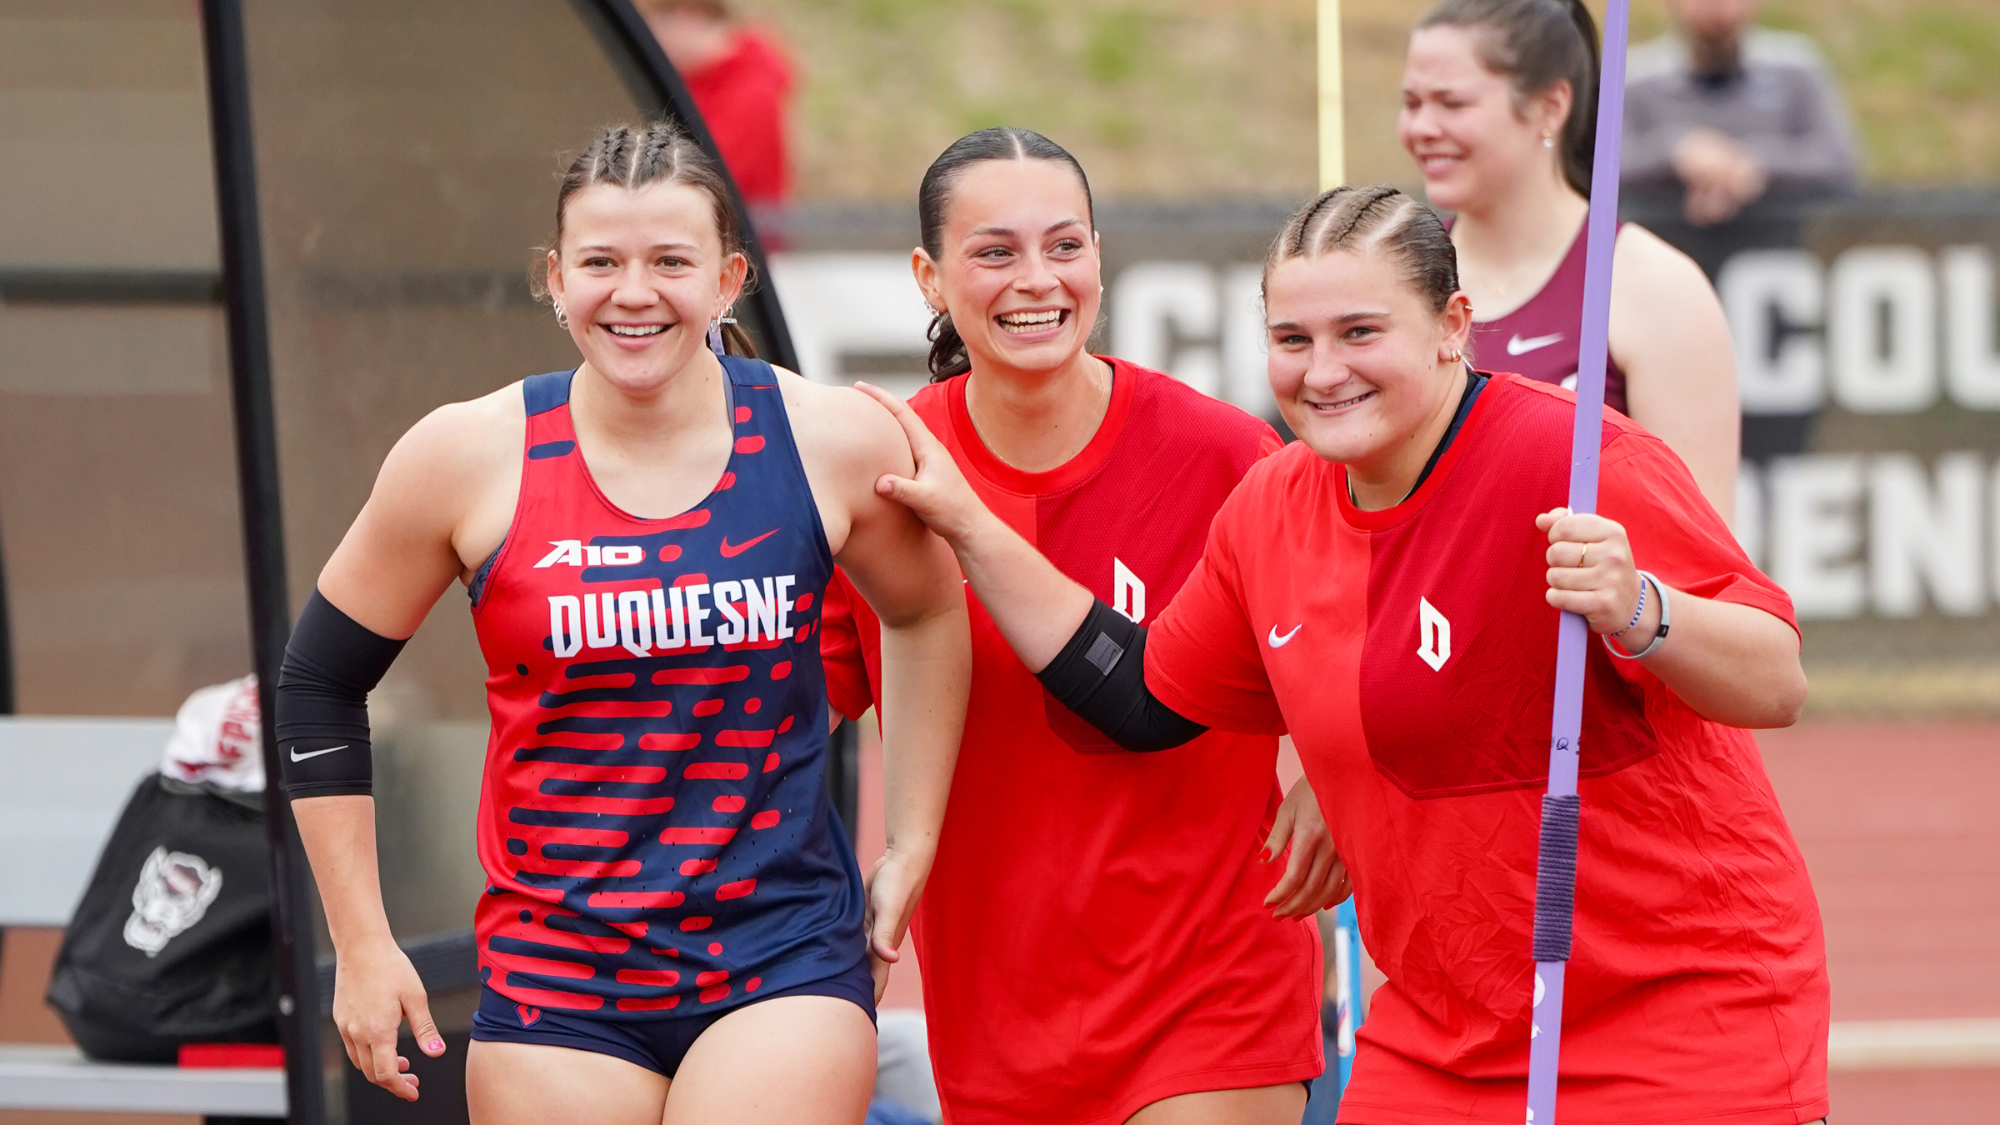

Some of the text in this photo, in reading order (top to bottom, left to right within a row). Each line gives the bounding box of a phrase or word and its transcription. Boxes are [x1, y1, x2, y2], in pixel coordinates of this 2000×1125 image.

[533, 540, 642, 568] A10
[547, 574, 796, 658] DUQUESNE
[1416, 595, 1451, 672] D
